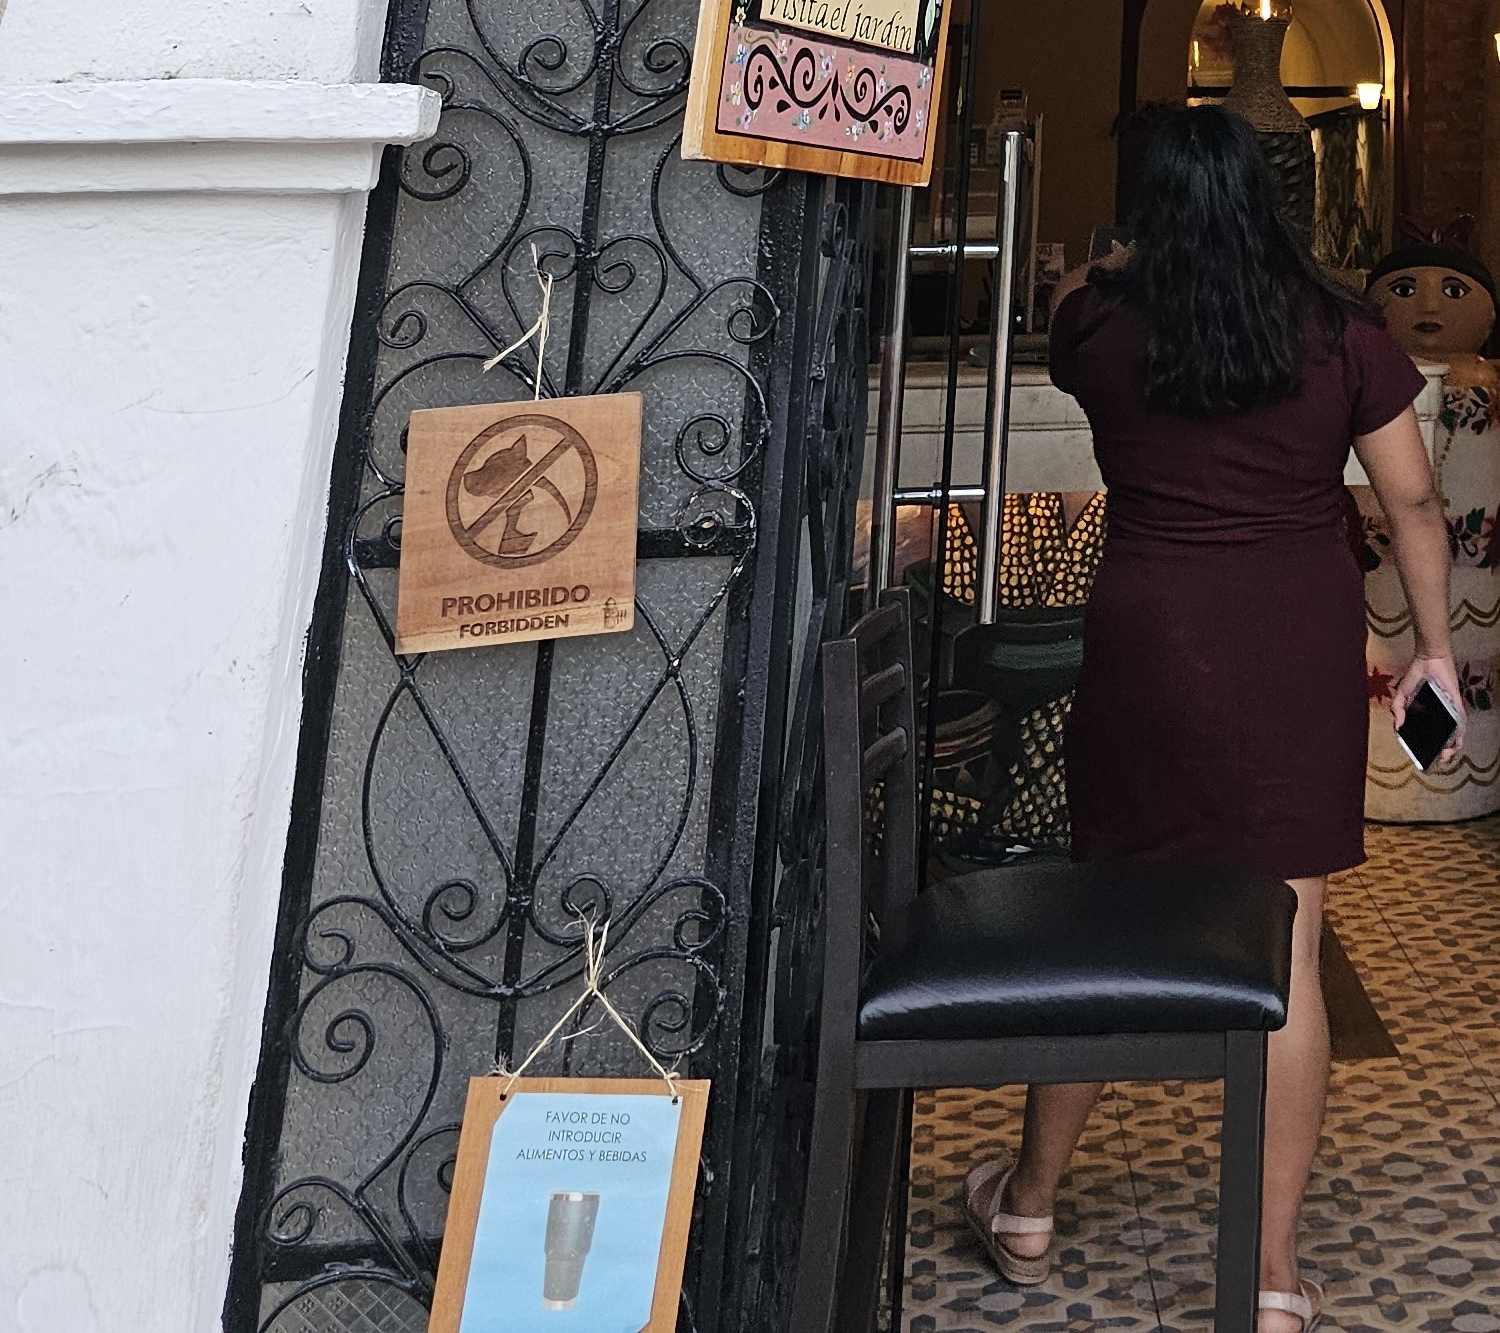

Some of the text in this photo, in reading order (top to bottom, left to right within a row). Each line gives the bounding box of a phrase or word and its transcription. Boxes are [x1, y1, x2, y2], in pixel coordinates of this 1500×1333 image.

[441, 583, 591, 618] PROHIBIDO
[458, 613, 570, 640] FORBIDDEN
[545, 1111, 631, 1125] FAVOR DE NO
[547, 1130, 622, 1144] INTRODUCIR
[516, 1148, 648, 1163] ALIMENTOS Y BEBIDAS
